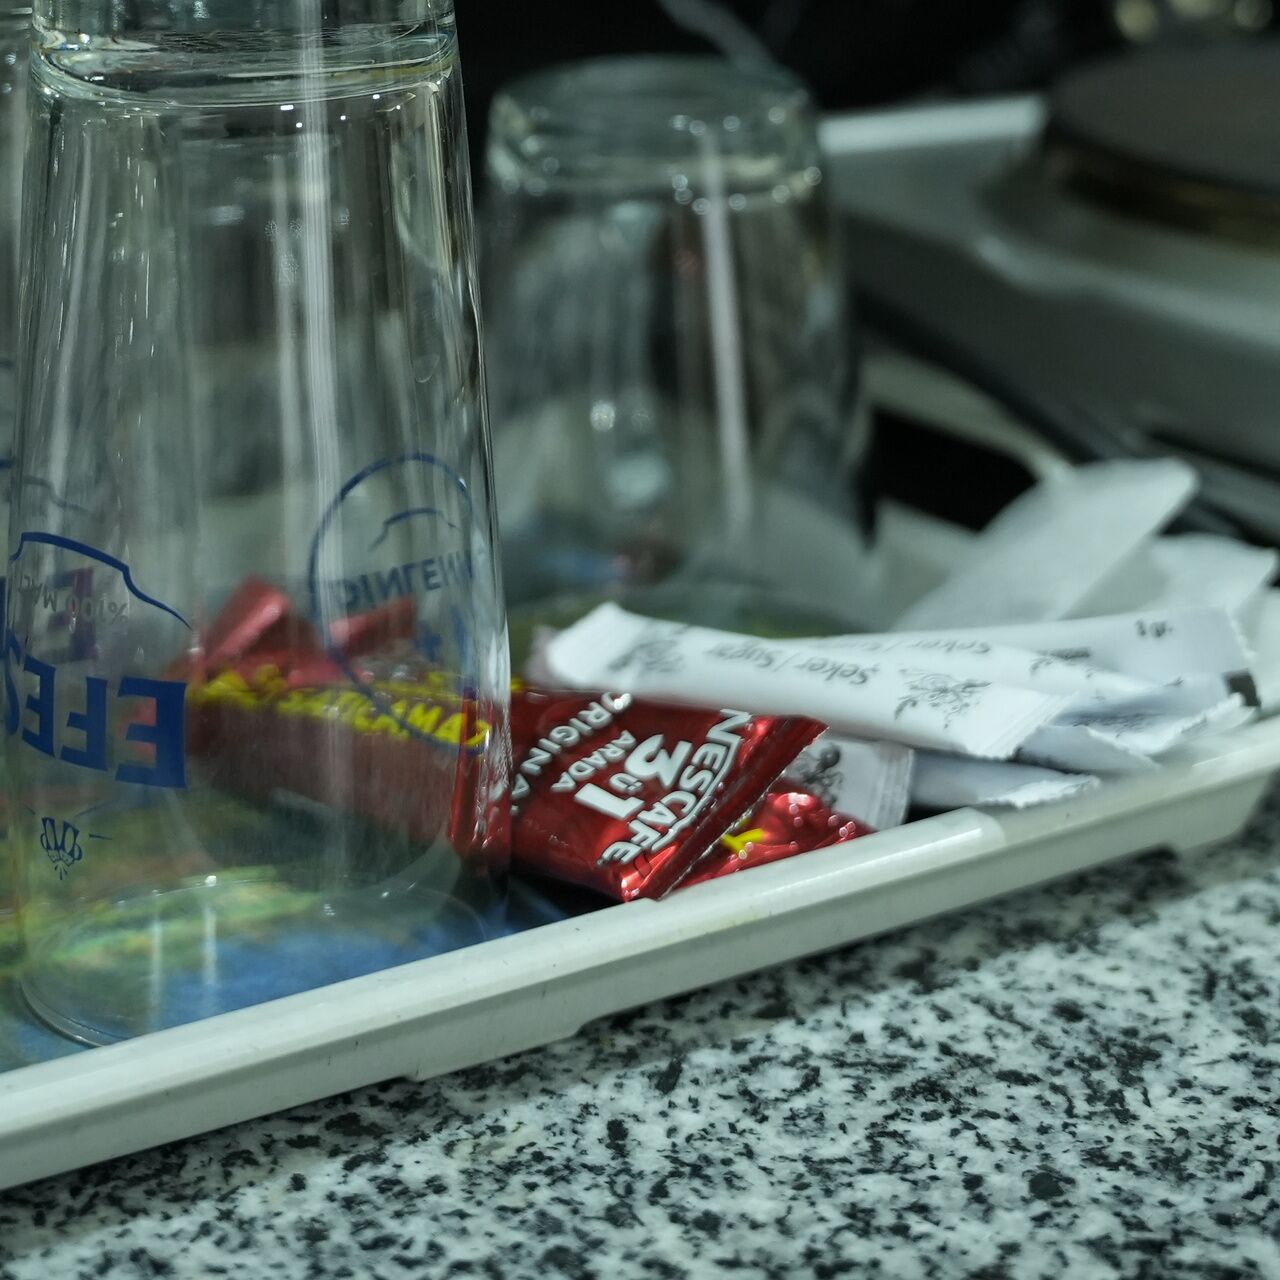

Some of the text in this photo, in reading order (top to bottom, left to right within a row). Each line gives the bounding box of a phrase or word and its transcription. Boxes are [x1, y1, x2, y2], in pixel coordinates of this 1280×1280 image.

[4, 629, 188, 790] EFES
[510, 691, 634, 816] ORIGINA
[550, 729, 637, 793] ARADA
